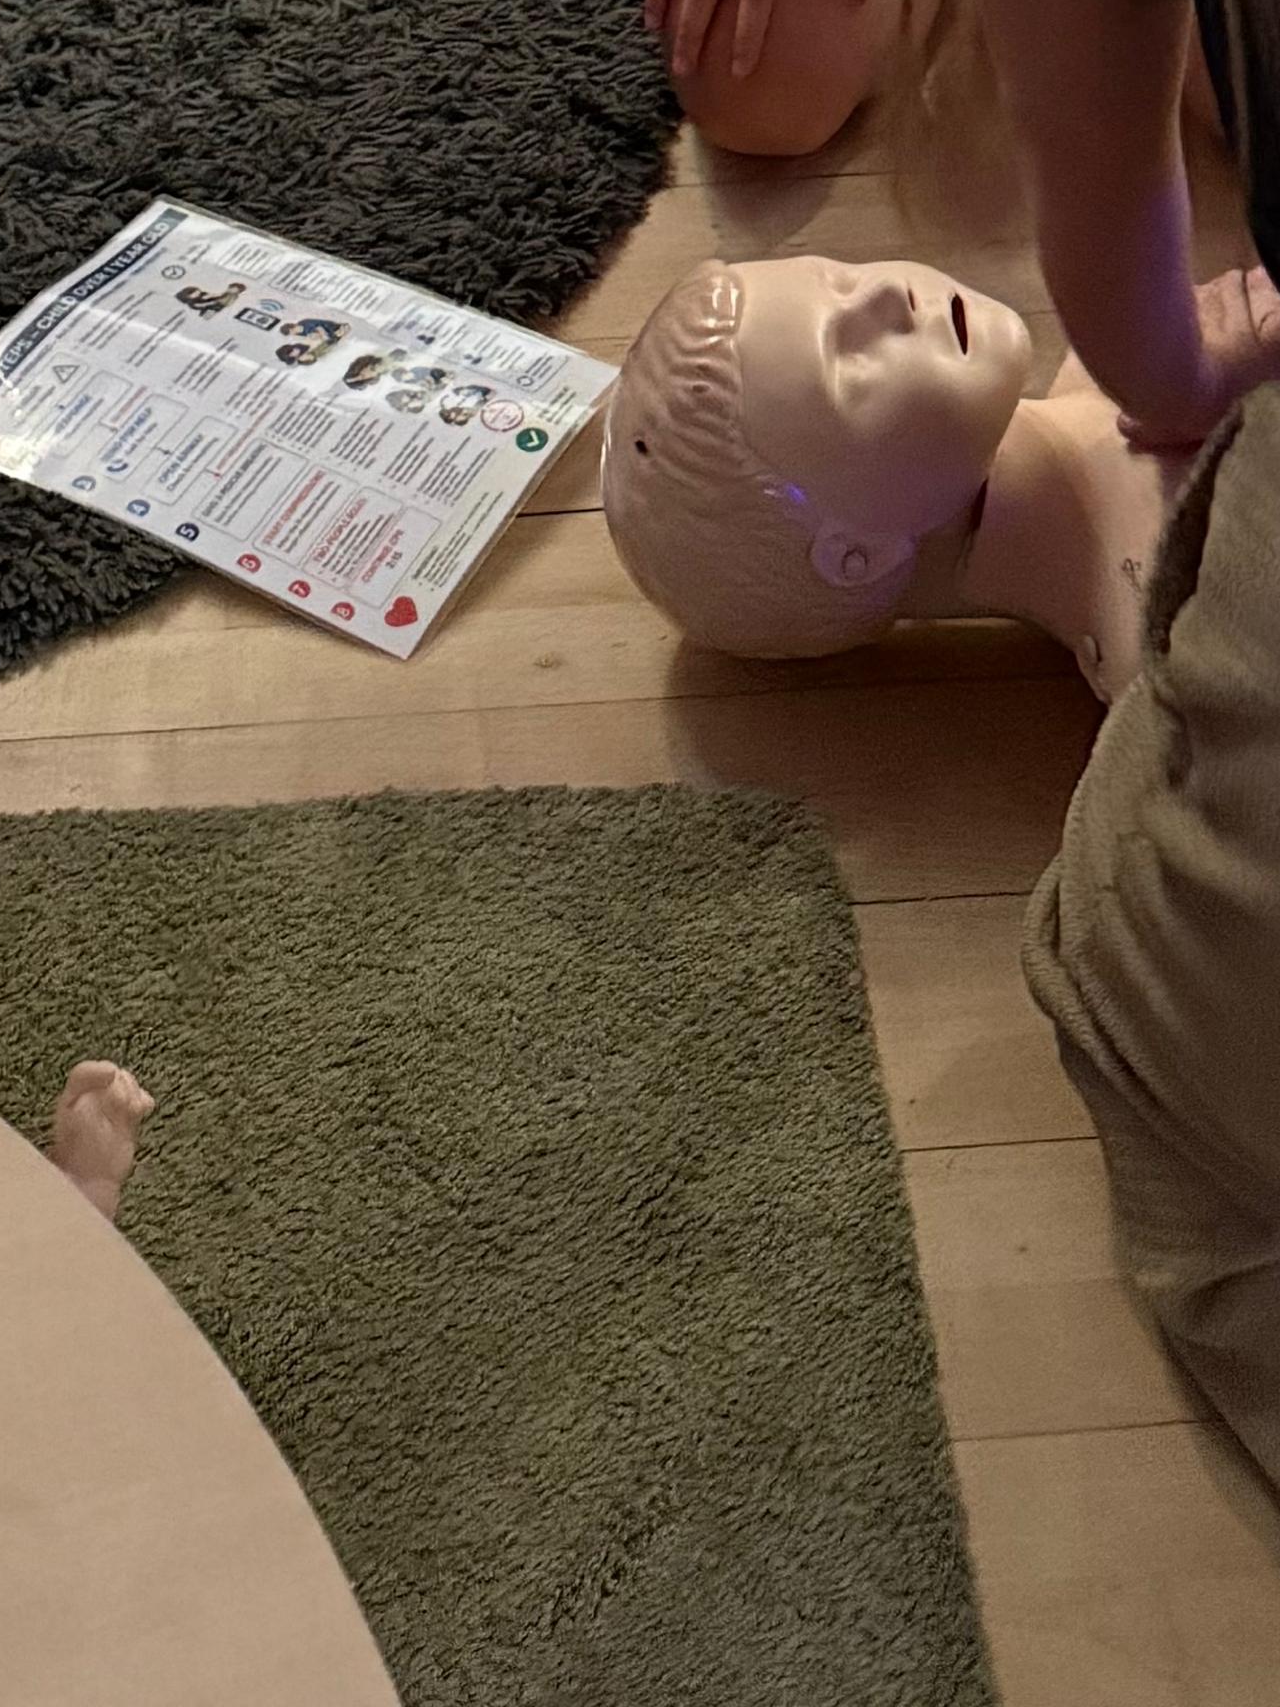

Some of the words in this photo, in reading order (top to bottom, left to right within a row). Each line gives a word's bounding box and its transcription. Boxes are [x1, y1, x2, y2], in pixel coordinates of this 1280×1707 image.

[33, 294, 79, 331] CHILD
[71, 270, 109, 297] OVER
[109, 241, 148, 268] YEAR
[139, 221, 172, 244] OLD
